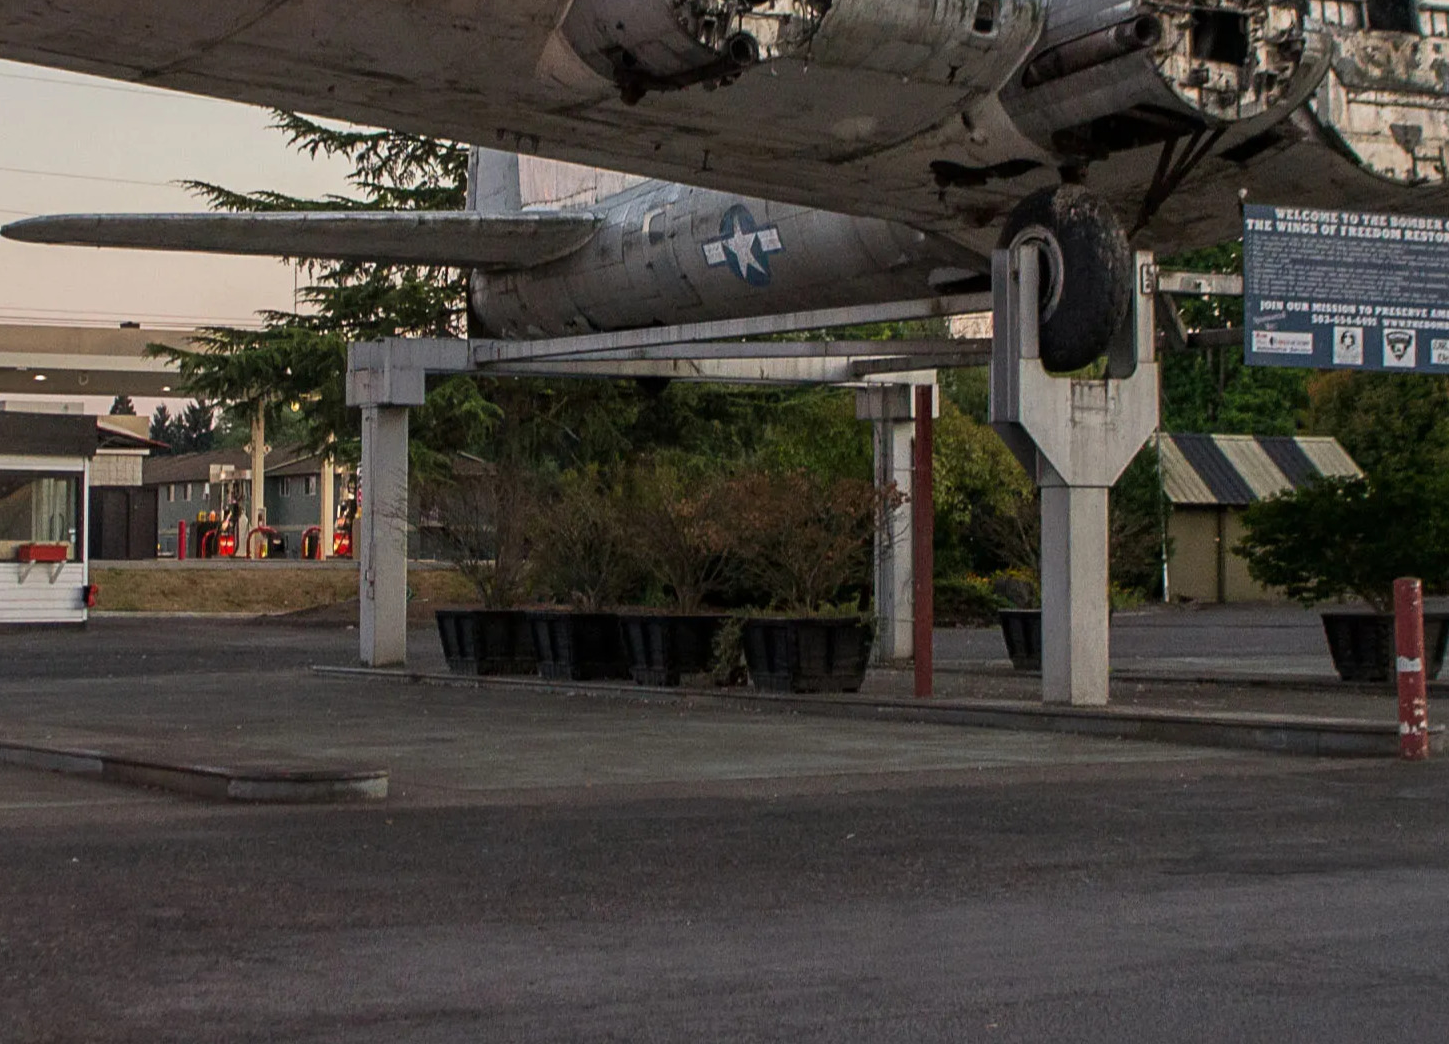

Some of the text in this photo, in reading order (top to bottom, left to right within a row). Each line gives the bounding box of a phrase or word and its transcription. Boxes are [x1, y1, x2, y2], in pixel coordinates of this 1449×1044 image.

[1274, 209, 1338, 222] WELCOME
[1341, 213, 1359, 223] TO
[1362, 215, 1387, 225] THE
[1390, 216, 1442, 228] BOMBER
[1246, 220, 1272, 230] THE
[1275, 222, 1317, 233] WINGS
[1321, 225, 1337, 235] OF
[1340, 226, 1401, 238] FREEDOM
[1260, 300, 1283, 310] JOIN
[1286, 302, 1308, 311] OUR
[1311, 303, 1356, 313] MISSION
[1358, 305, 1372, 315] TO
[1375, 307, 1427, 317] PRESERVE
